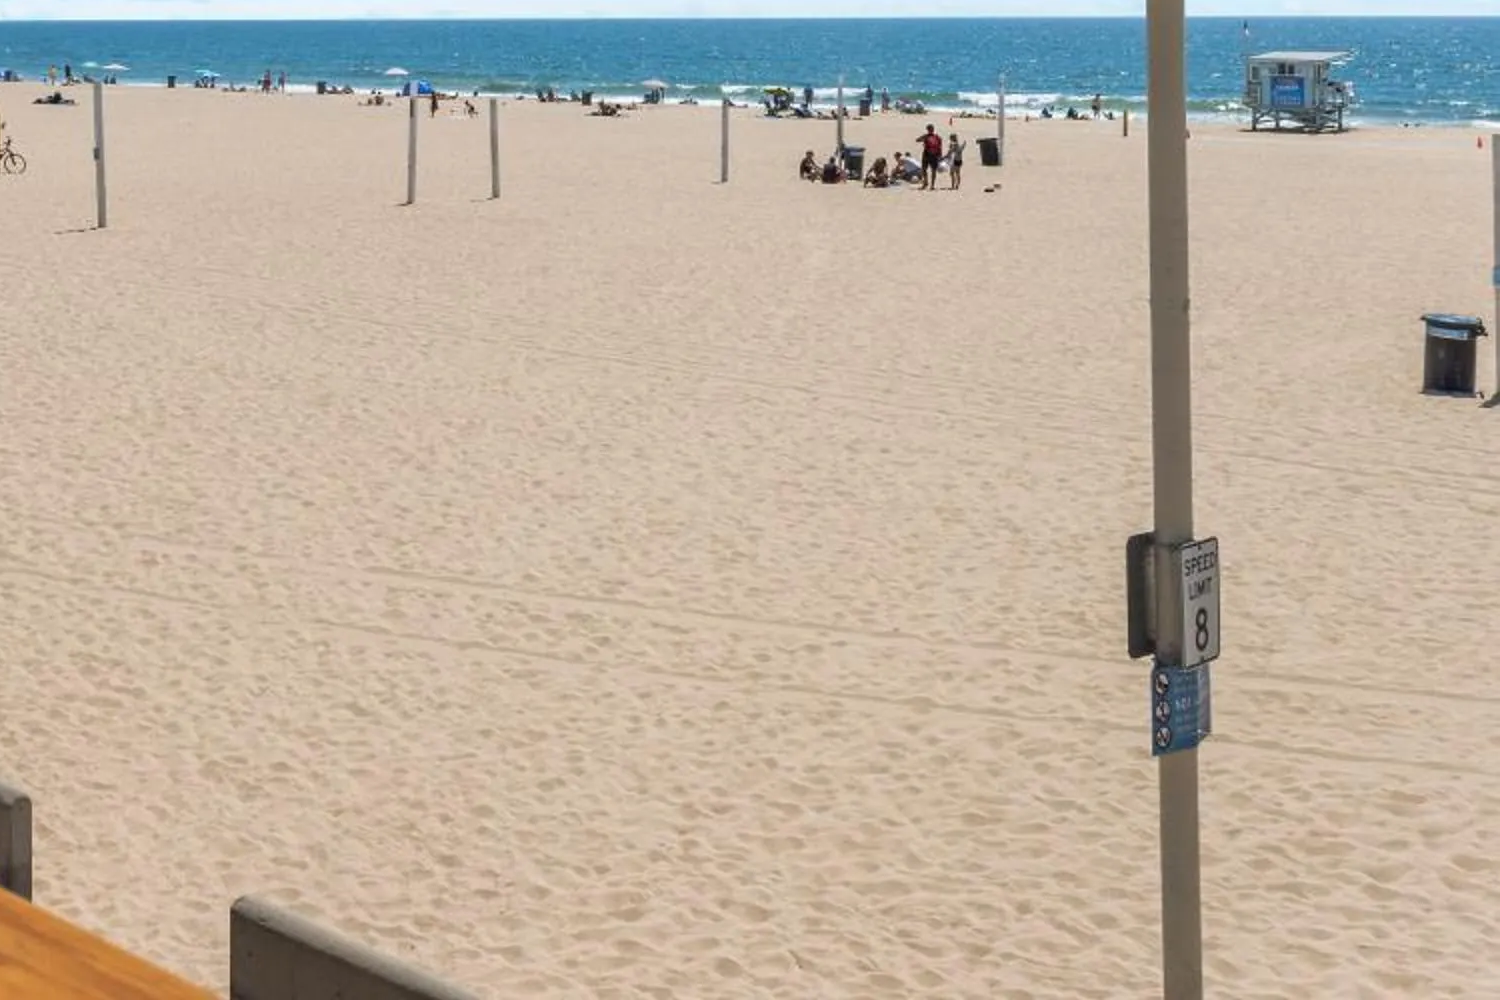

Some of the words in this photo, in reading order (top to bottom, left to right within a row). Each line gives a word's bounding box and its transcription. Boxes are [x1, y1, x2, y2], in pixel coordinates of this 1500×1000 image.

[1184, 551, 1215, 576] SPEED
[1188, 577, 1212, 600] LIMIT
[1195, 608, 1208, 651] 8
